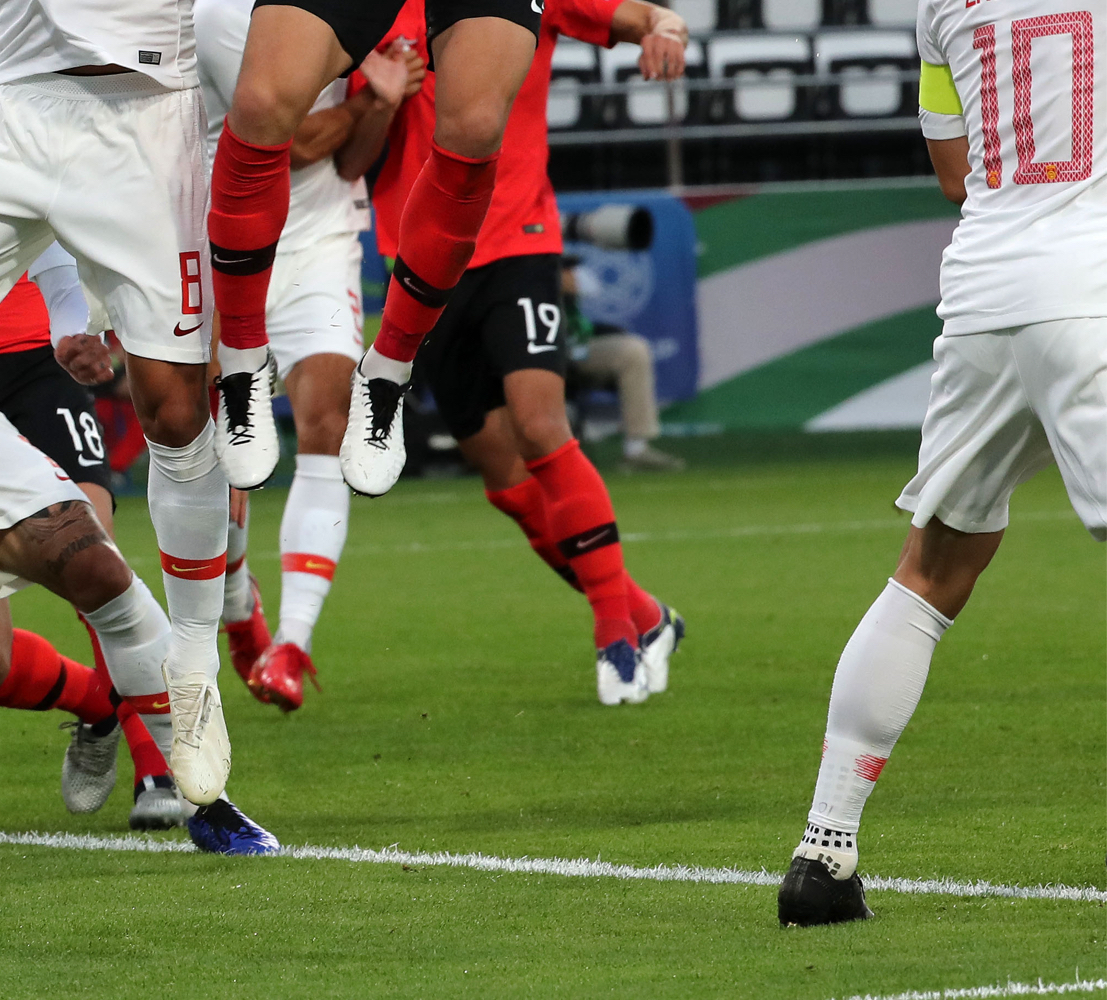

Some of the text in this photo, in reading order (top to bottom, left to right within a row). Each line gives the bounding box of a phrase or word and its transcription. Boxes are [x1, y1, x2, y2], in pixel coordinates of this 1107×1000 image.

[972, 10, 1095, 189] 10
[179, 251, 203, 315] 8
[517, 297, 561, 344] 19
[56, 407, 105, 460] 18
